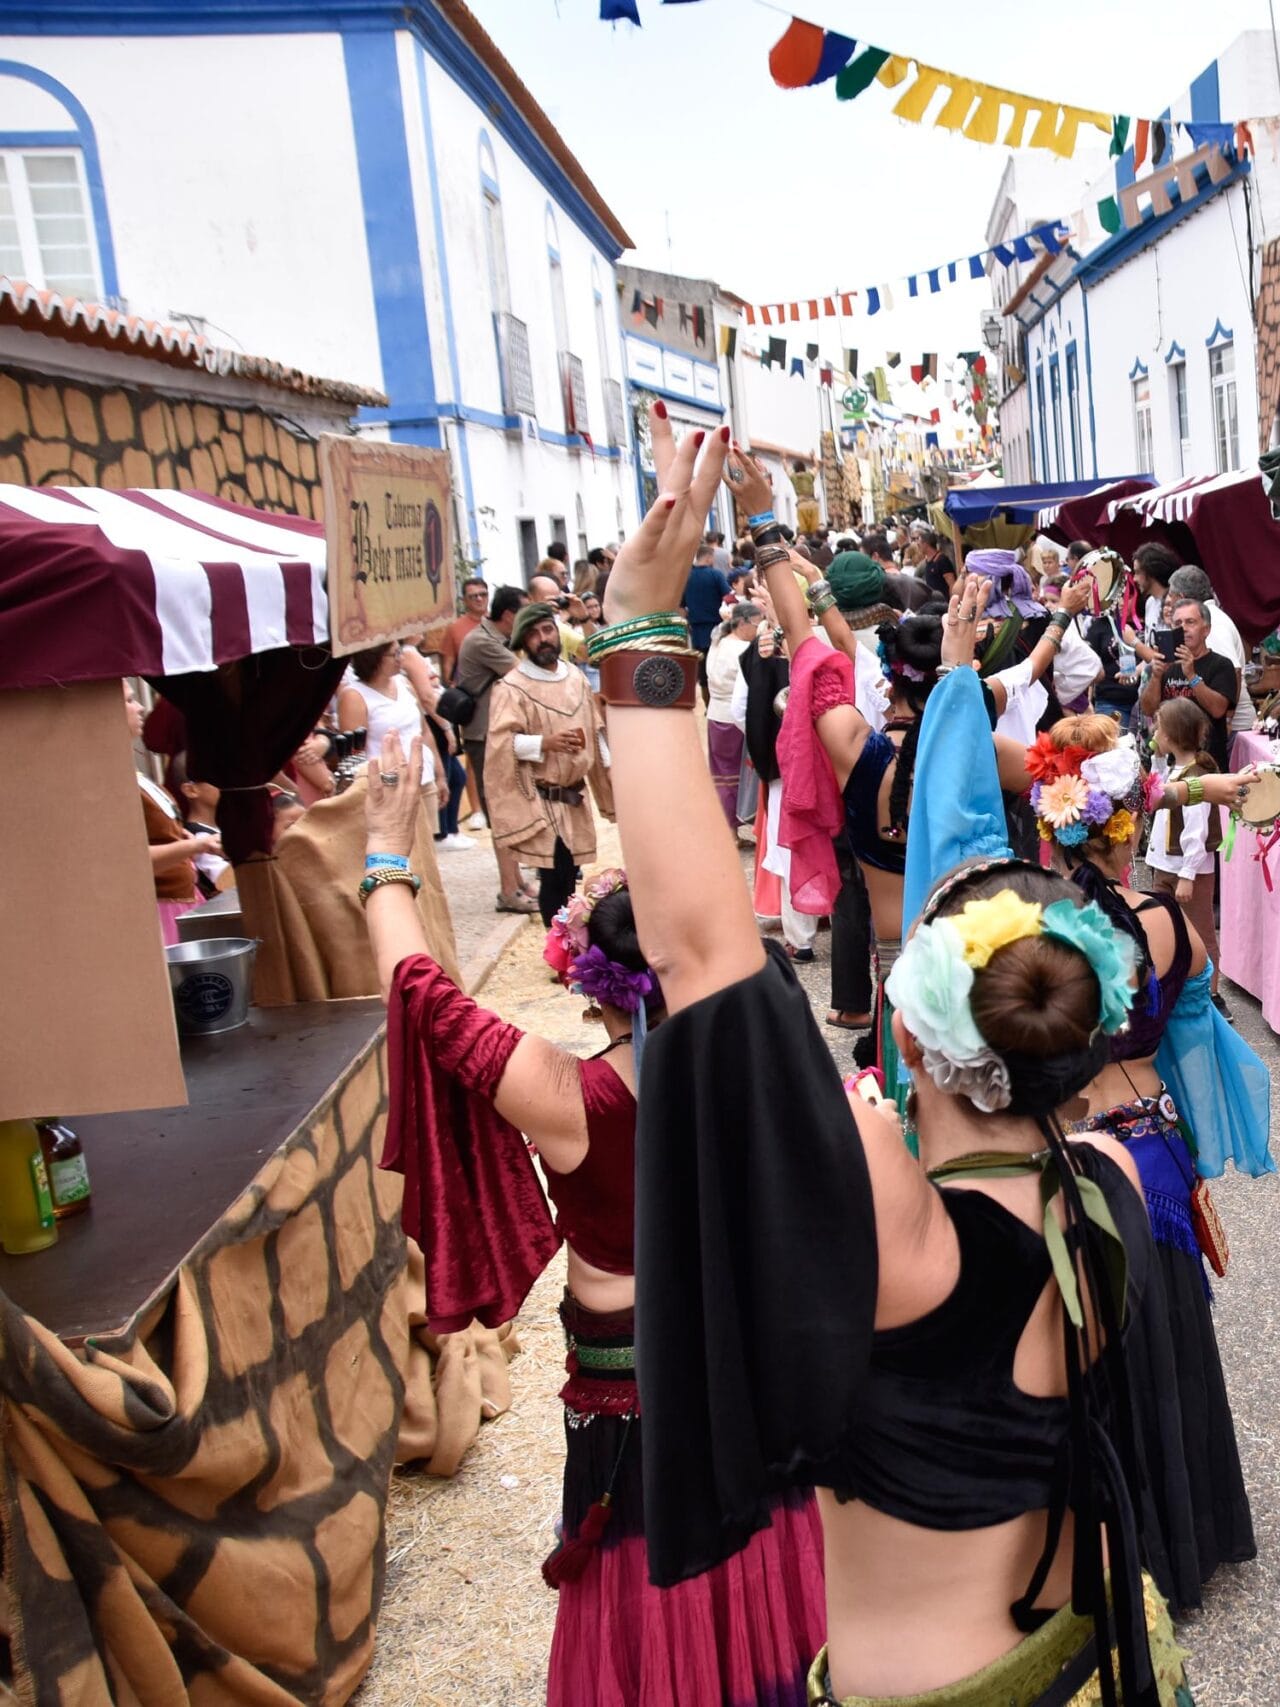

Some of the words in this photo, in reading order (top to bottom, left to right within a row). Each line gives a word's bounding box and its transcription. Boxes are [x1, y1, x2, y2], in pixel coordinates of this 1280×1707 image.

[350, 499, 391, 584] Bebe
[394, 545, 423, 581] mais
[383, 491, 422, 530] Taberna
